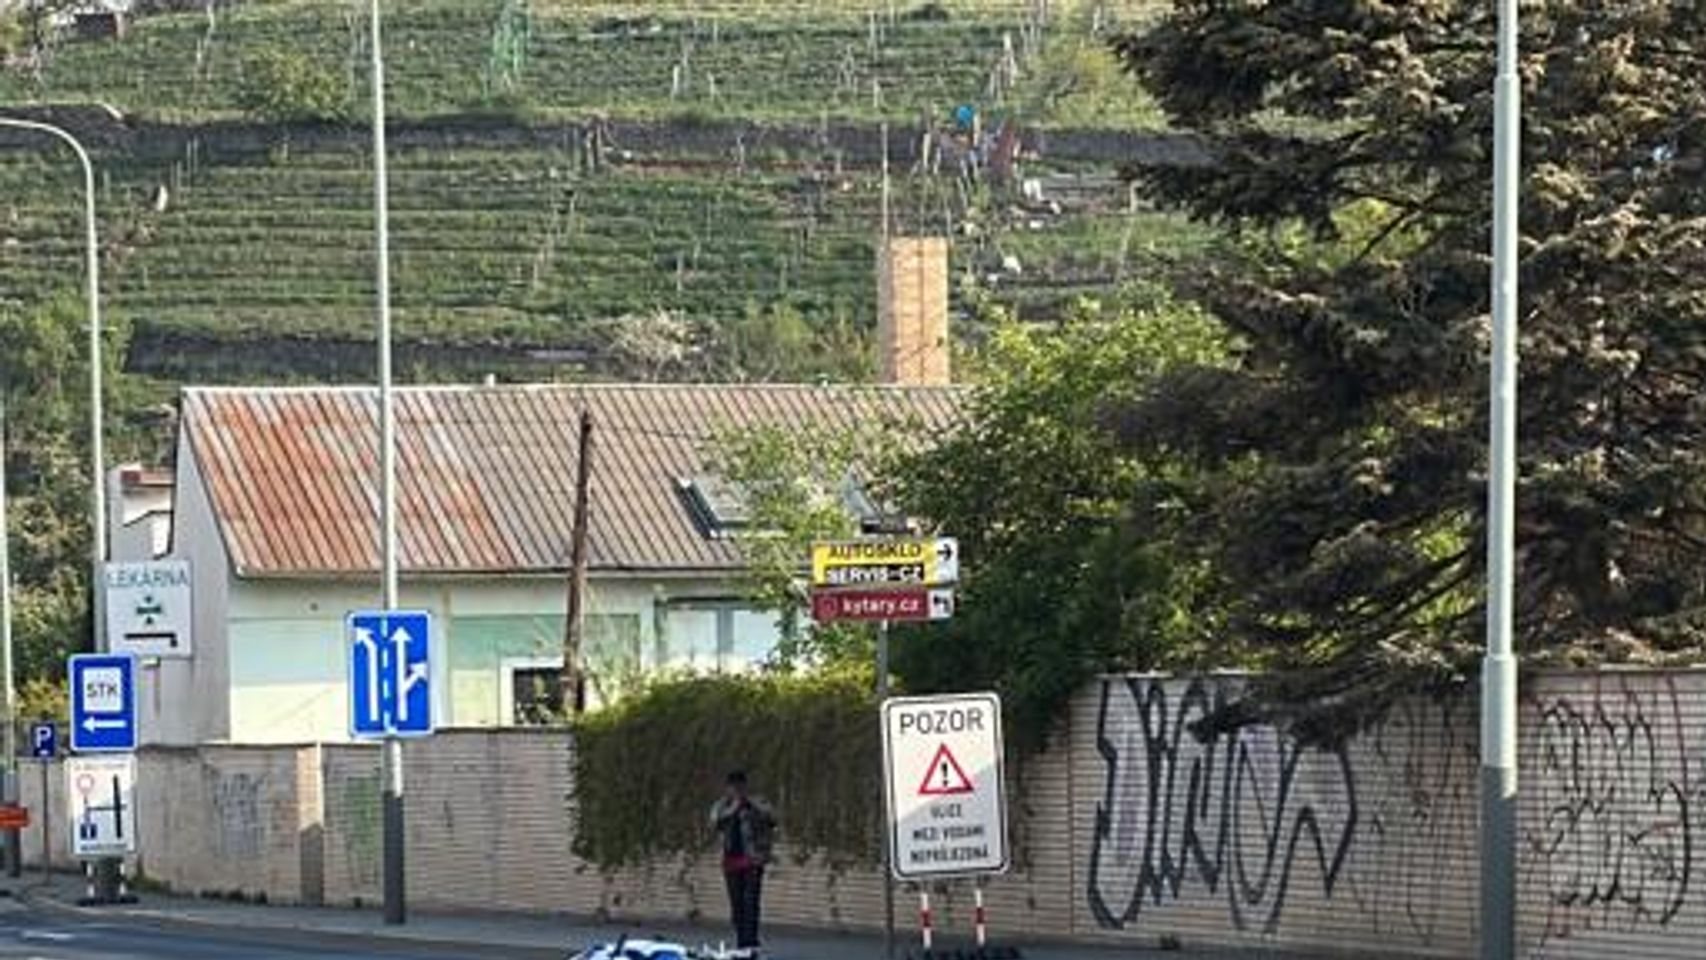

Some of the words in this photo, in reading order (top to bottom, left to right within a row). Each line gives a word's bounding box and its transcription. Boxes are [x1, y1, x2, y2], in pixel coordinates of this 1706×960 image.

[829, 543, 922, 559] AUTOSKLO
[843, 597, 919, 615] kytary.cz
[86, 683, 118, 699] STK
[900, 707, 985, 734] POZOR
